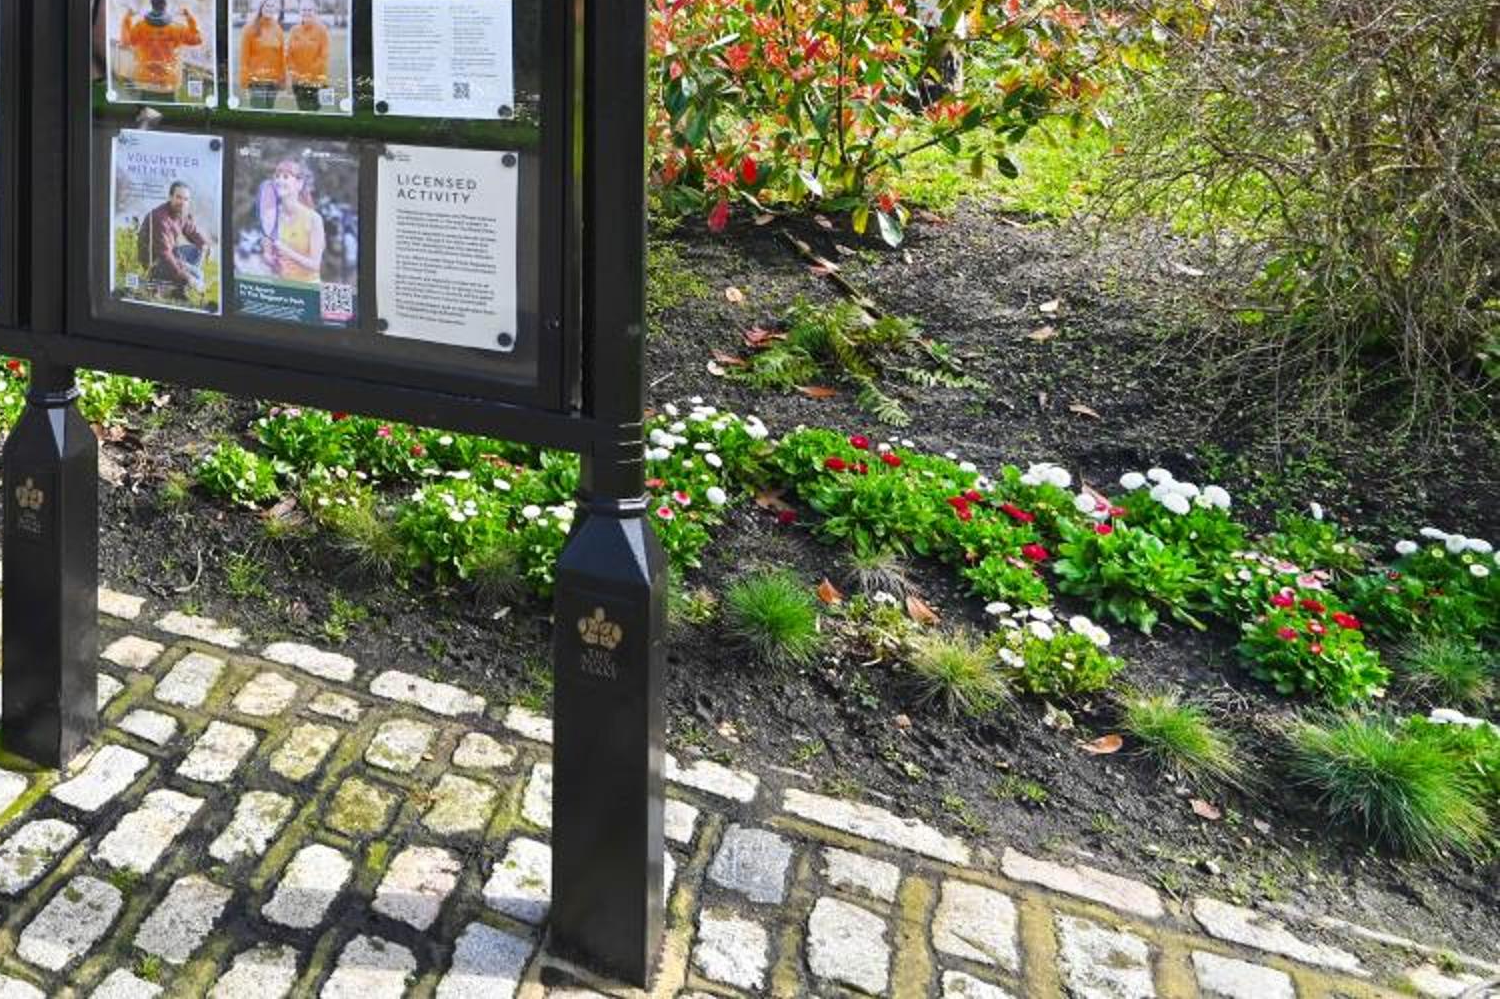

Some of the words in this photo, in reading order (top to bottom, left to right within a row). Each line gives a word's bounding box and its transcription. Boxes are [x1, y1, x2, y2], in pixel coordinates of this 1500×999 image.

[127, 152, 200, 168] VOLUNTEER
[396, 173, 478, 190] LICENSED
[396, 188, 472, 204] ACTIVITY
